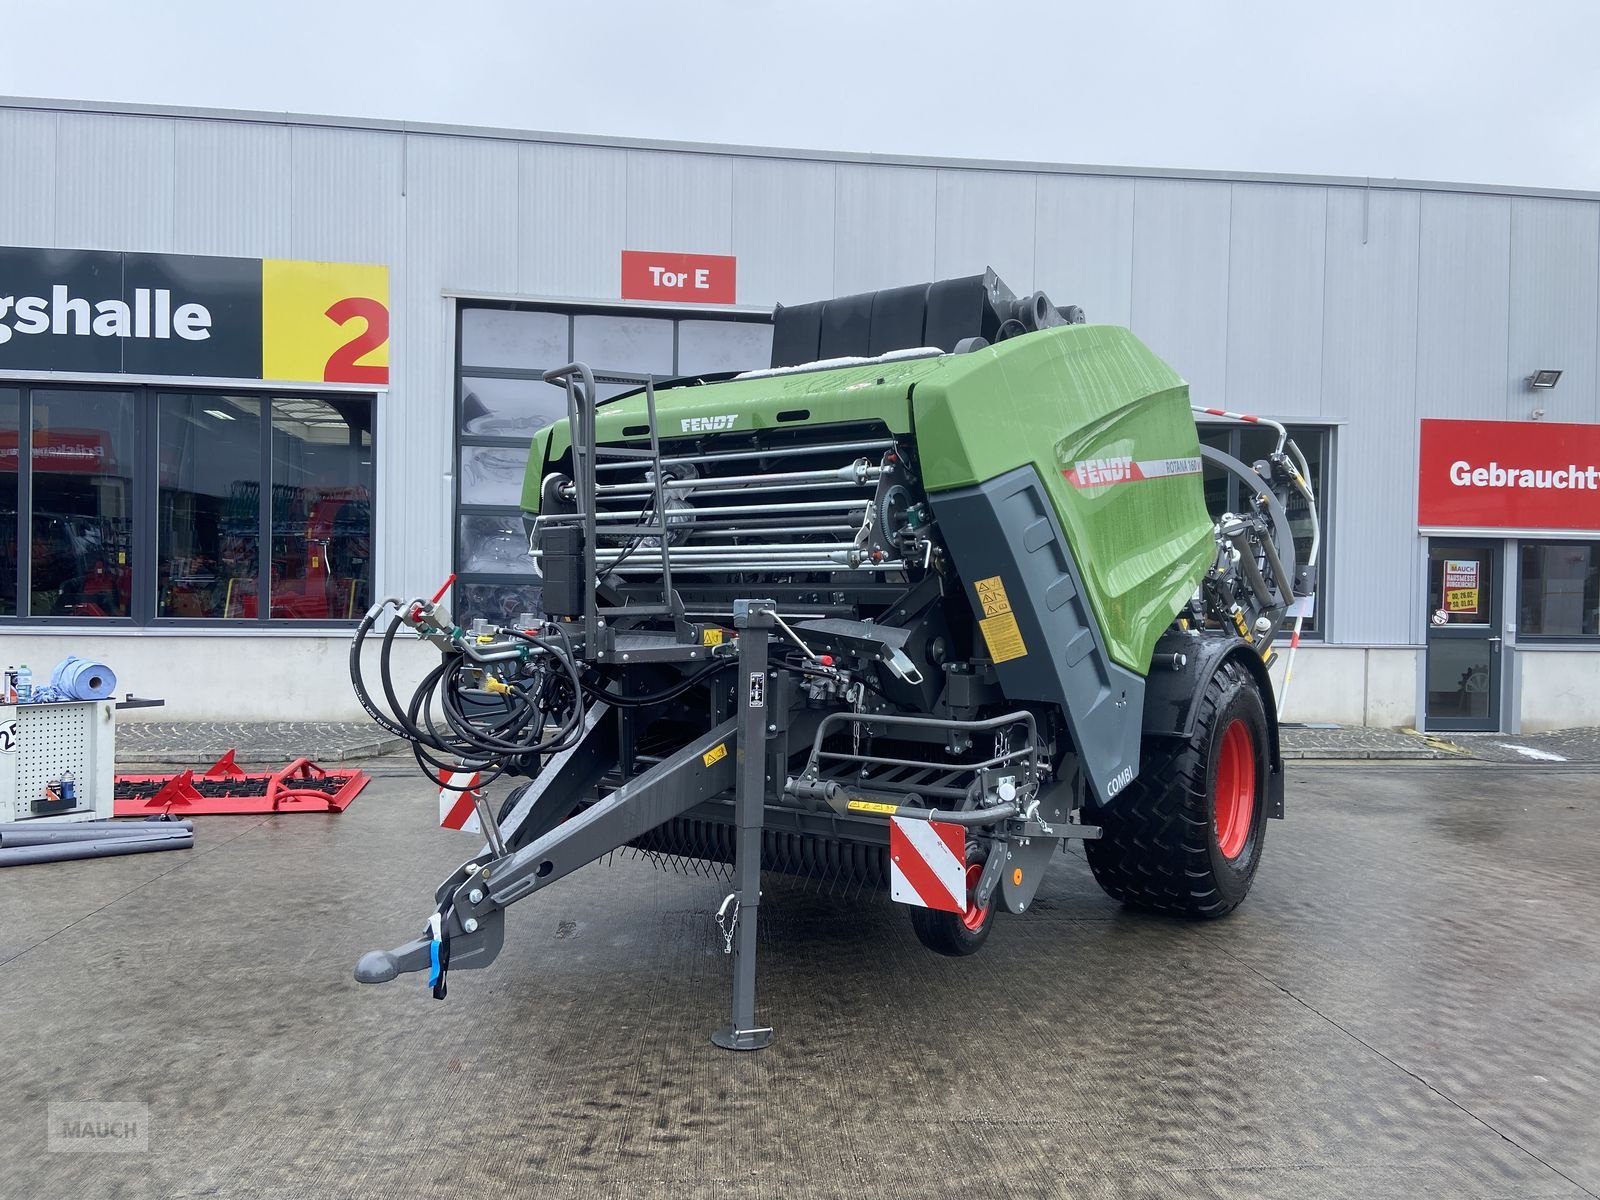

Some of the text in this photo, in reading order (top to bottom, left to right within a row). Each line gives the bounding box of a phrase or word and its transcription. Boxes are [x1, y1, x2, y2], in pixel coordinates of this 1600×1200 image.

[648, 266, 710, 289] Tor E
[323, 296, 389, 385] 2
[680, 414, 739, 433] FENDT
[1074, 456, 1133, 485] FENDT
[1165, 461, 1188, 474] ROTANA
[1449, 460, 1600, 490] Gebraucht
[1451, 565, 1475, 573] MAUCH
[1107, 765, 1133, 797] COMBI
